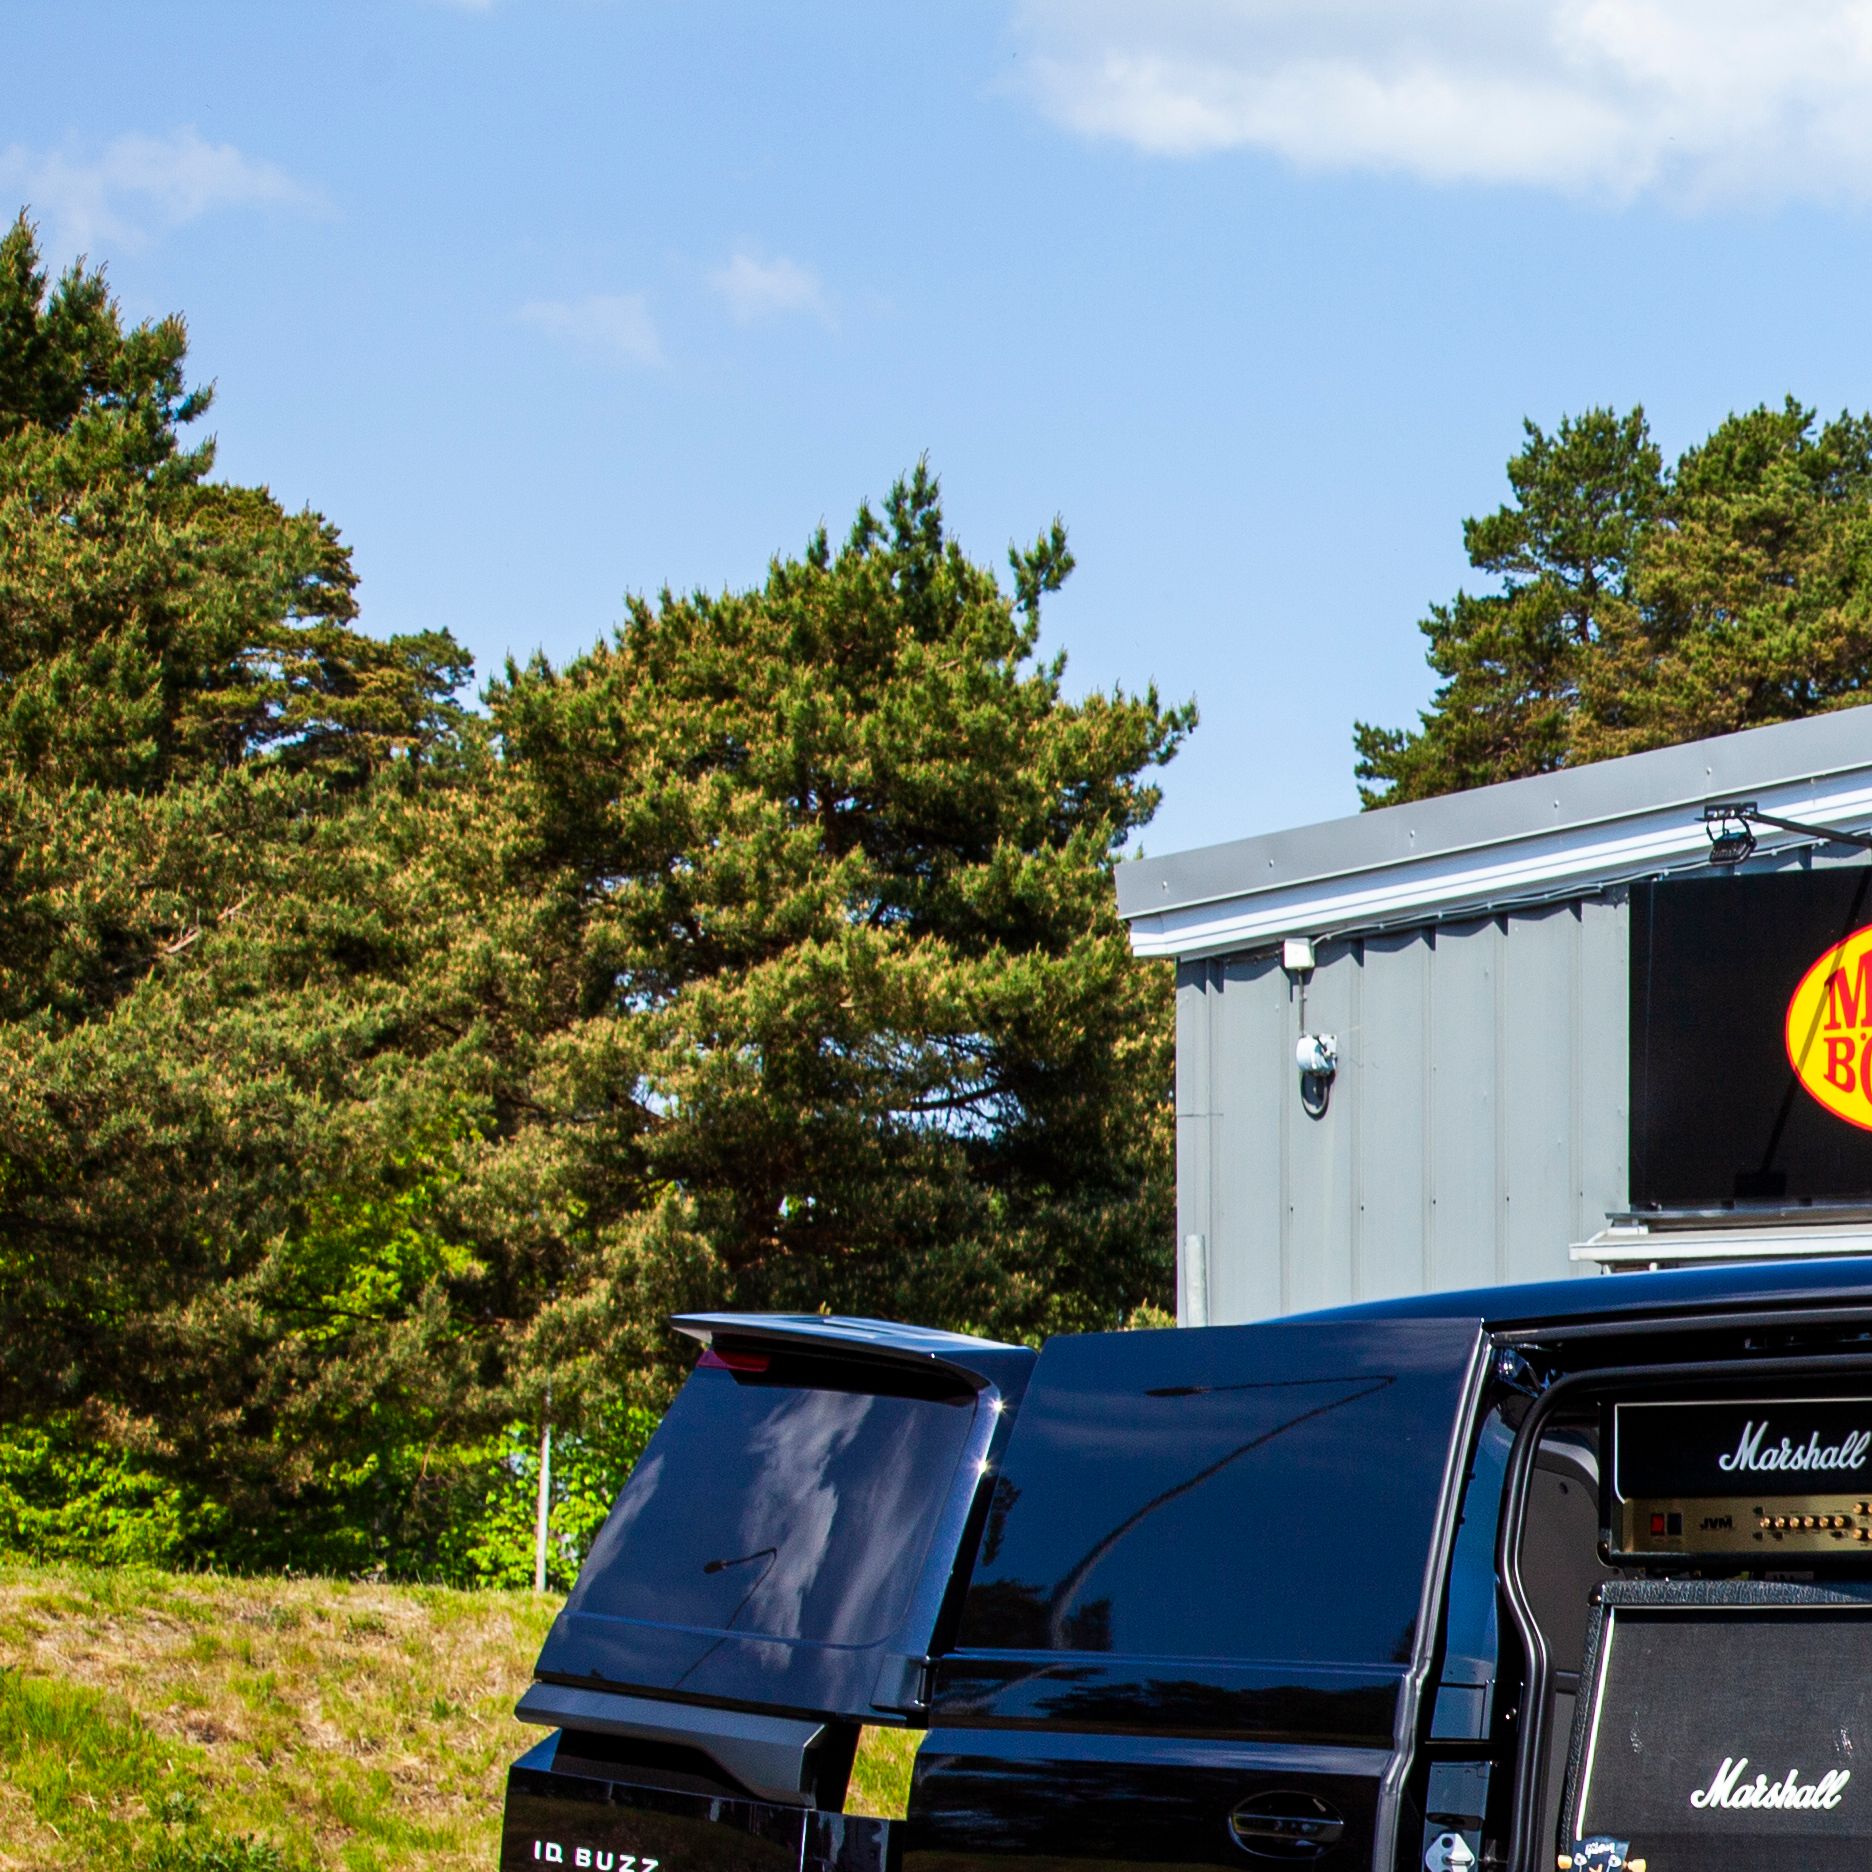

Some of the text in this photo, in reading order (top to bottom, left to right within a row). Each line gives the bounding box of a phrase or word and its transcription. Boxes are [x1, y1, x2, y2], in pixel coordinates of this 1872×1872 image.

[1718, 1421, 1872, 1472] Marshall
[1700, 1515, 1733, 1530] JVM
[1690, 1758, 1851, 1810] Marshall
